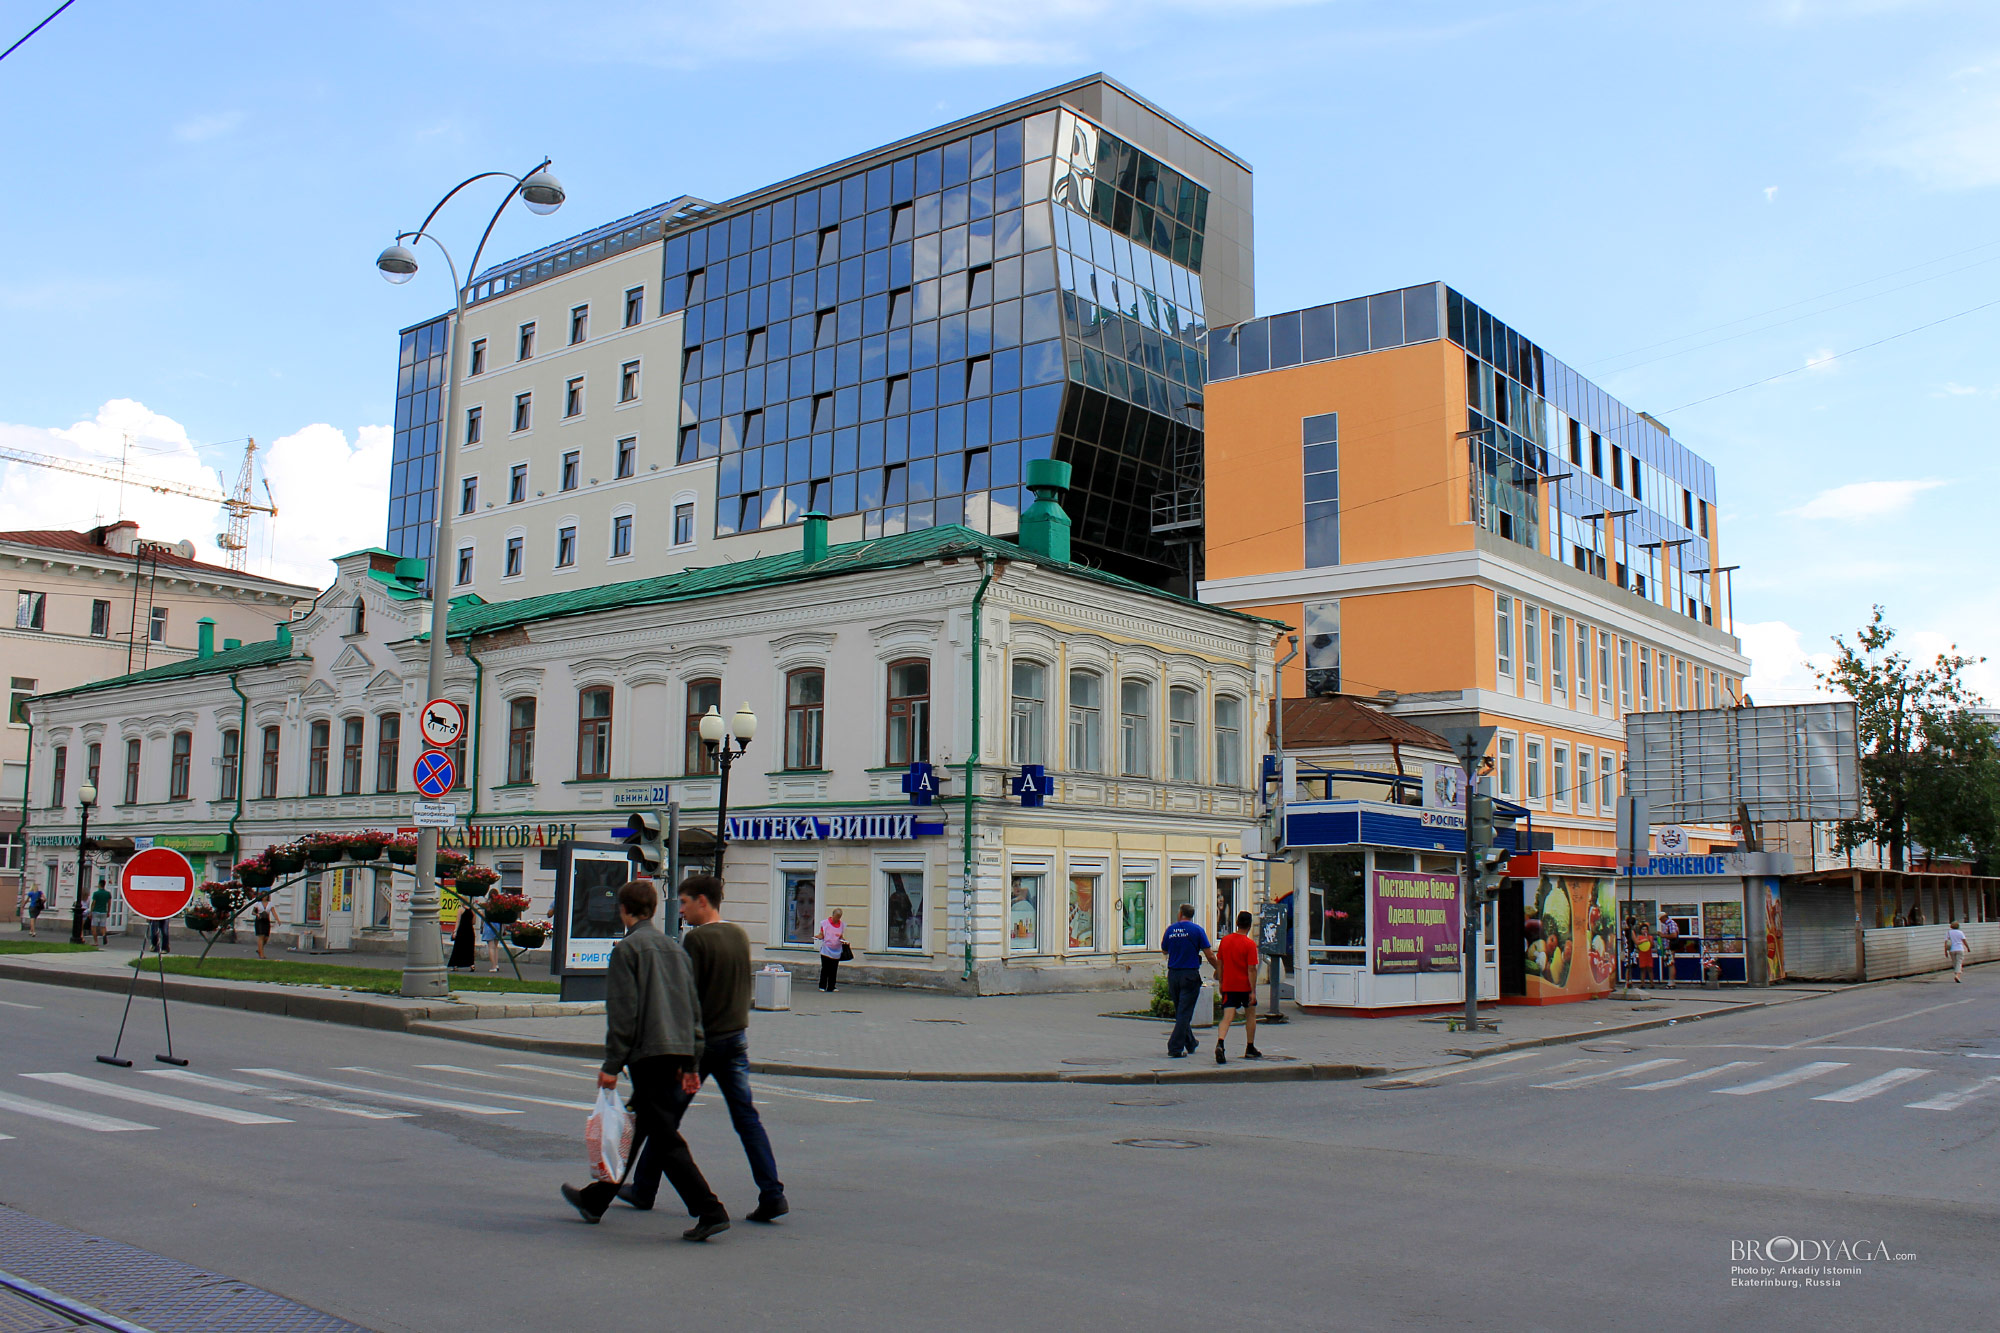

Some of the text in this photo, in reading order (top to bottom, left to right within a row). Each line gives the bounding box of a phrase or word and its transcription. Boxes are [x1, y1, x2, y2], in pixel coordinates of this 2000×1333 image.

[919, 773, 932, 791] А
[1020, 774, 1037, 792] А
[615, 794, 649, 802] ЛЕНИНА
[652, 787, 664, 801] 22
[724, 814, 915, 840] АПТЕКА ВИШИ
[1430, 814, 1464, 827] РОСПЕЧ
[441, 824, 577, 849] КАНЦТОВАРЫ
[1379, 875, 1455, 900] Постельное белье
[1416, 935, 1424, 953] 20
[581, 953, 612, 962] РИВ ГО
